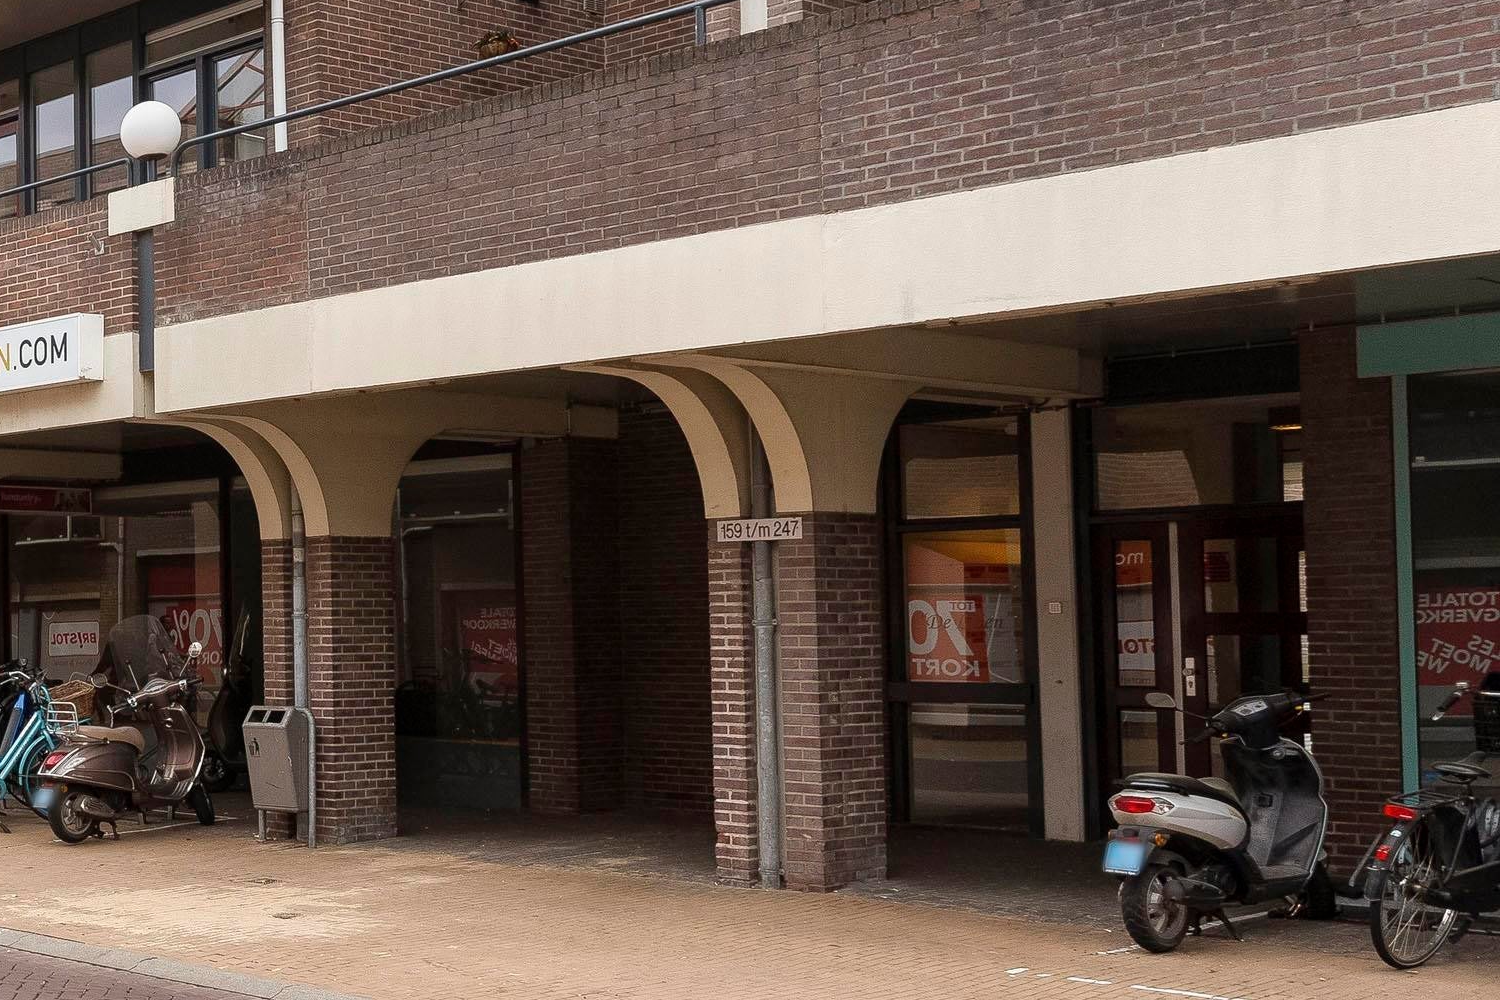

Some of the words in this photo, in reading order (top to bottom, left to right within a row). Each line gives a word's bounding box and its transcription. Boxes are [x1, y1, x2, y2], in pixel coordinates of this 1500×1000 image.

[720, 522, 742, 539] 159
[746, 521, 770, 538] t/m
[773, 520, 799, 537] 247
